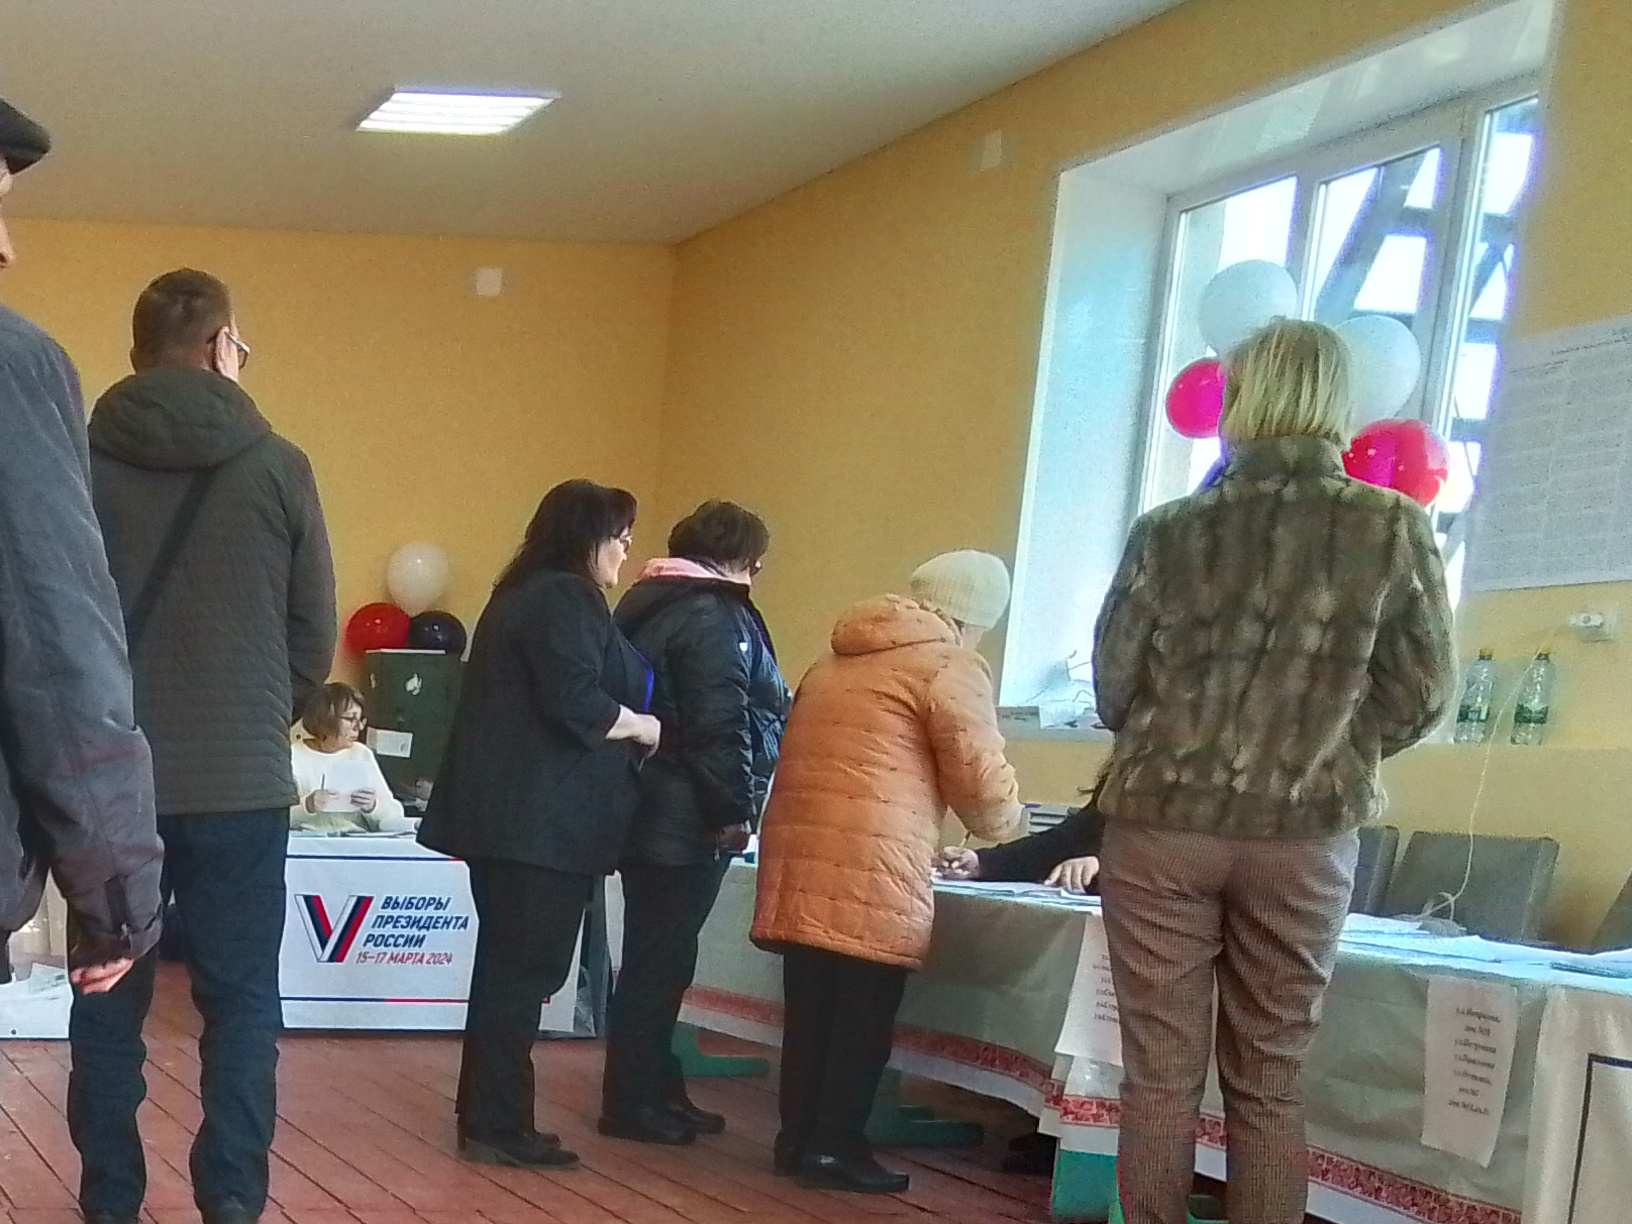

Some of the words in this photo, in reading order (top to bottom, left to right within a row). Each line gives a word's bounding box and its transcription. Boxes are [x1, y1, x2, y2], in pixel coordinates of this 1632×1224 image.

[380, 895, 452, 911] ВЫБОРЫ
[371, 915, 470, 932] ПРЕЗИДЕНТА
[362, 933, 427, 949] РОССИИ
[387, 951, 424, 966] МАРТА
[425, 952, 453, 966] 2024
